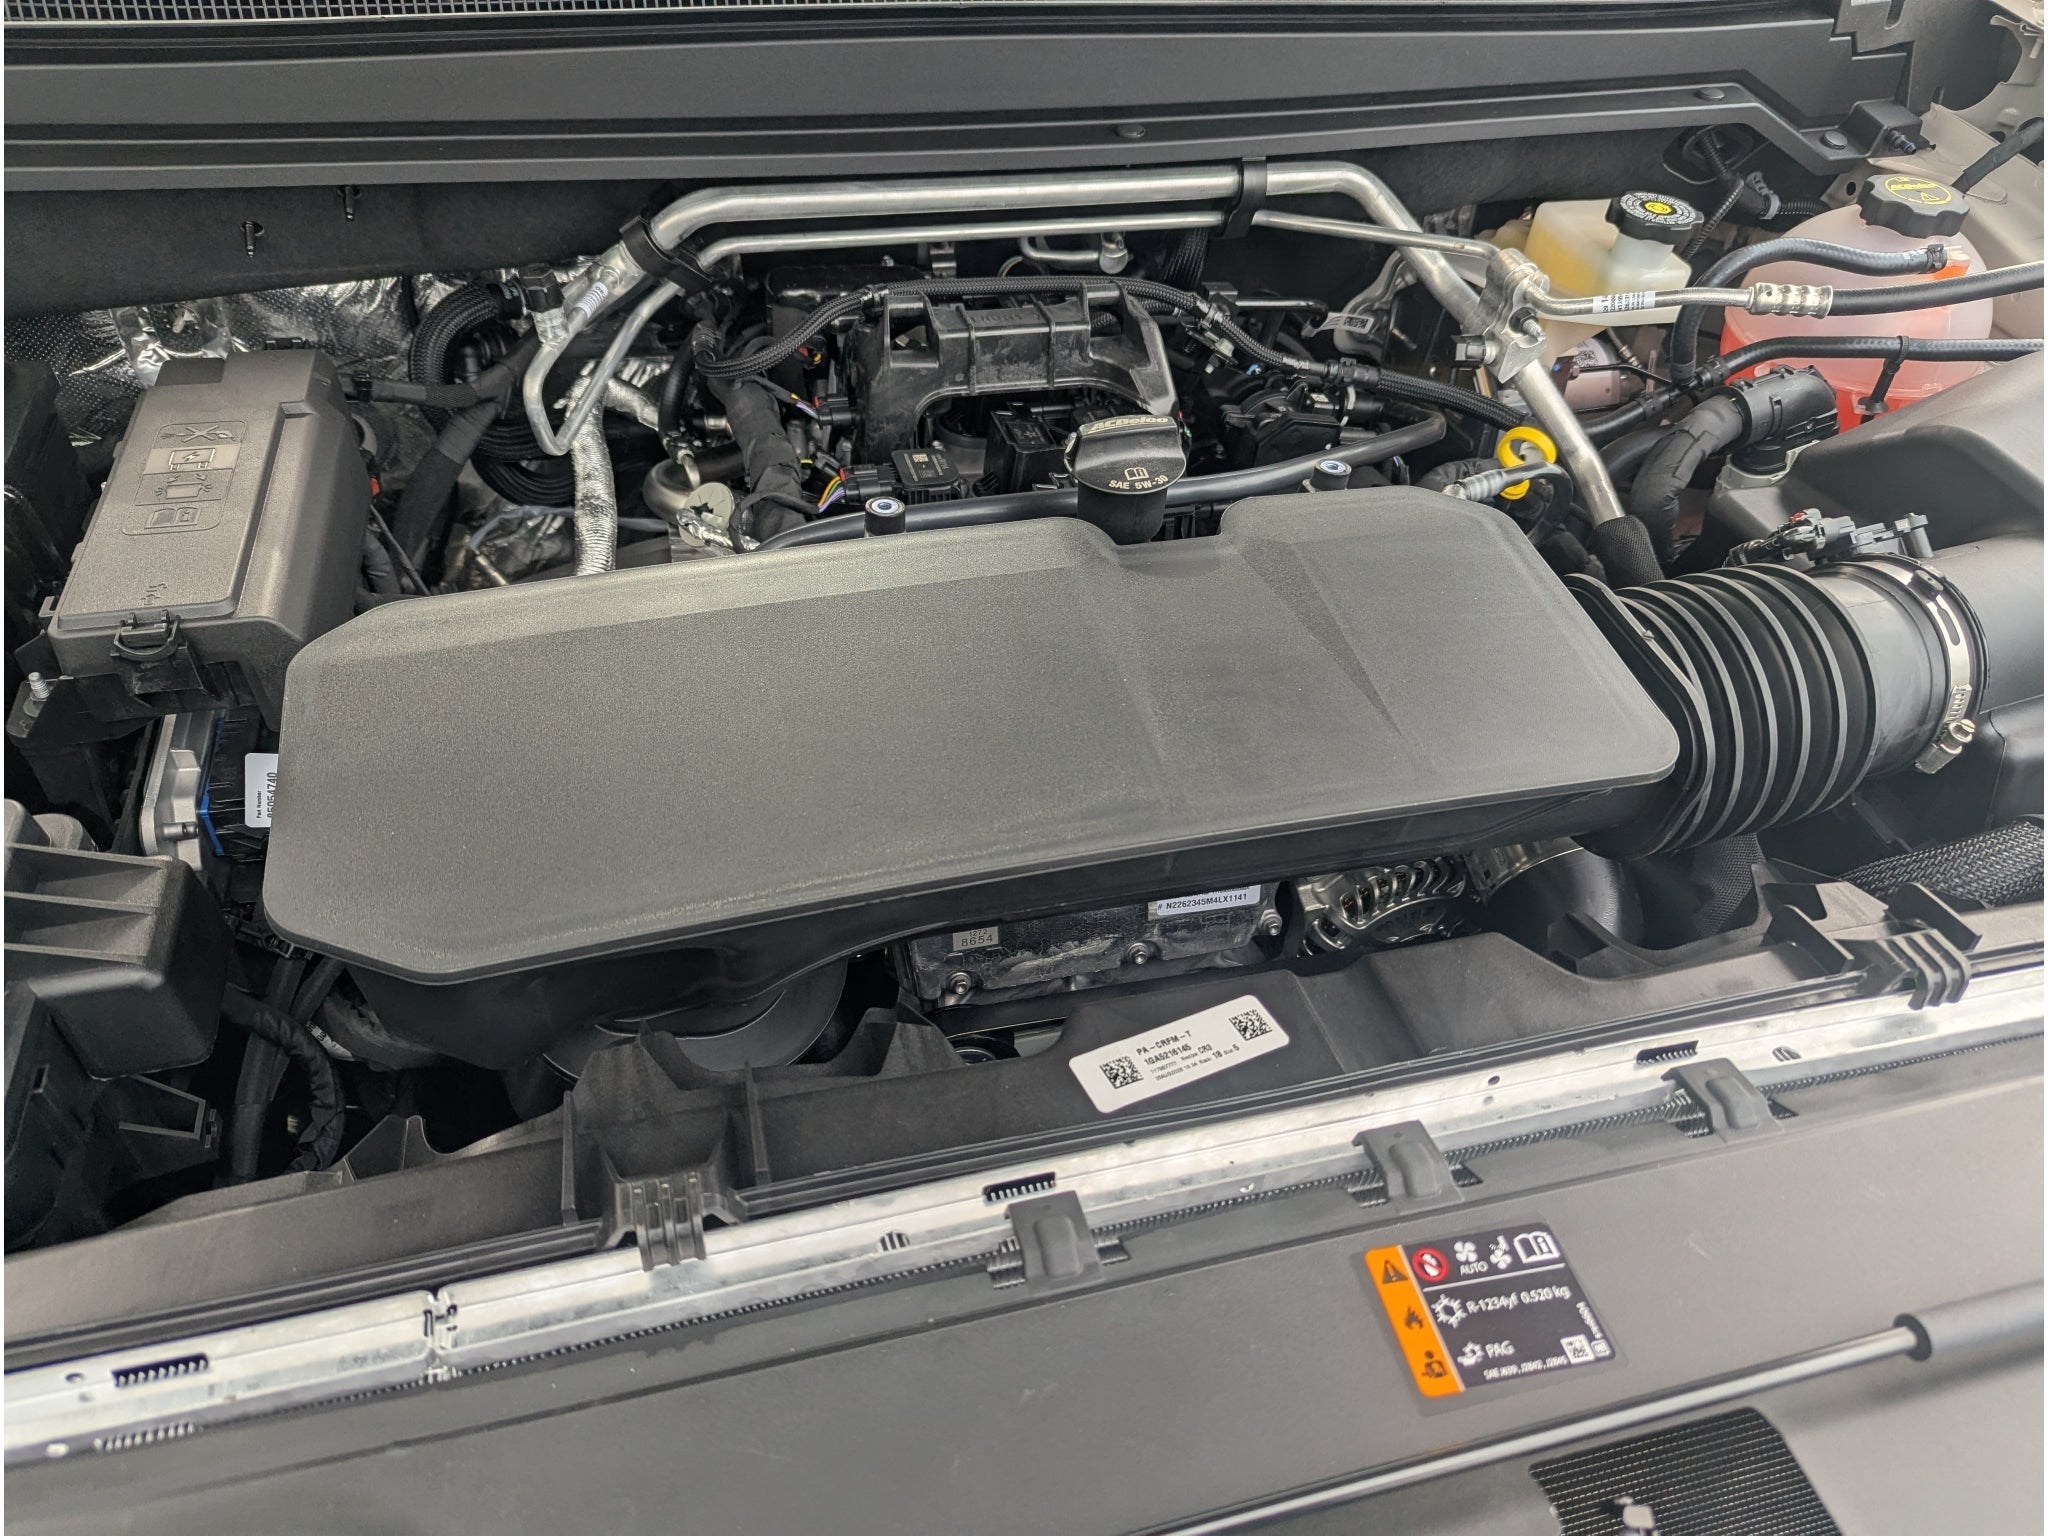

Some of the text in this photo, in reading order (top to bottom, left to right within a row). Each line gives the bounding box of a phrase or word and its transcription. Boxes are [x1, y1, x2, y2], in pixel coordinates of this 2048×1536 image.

[1087, 416, 1169, 434] ACDelco
[1108, 474, 1169, 490] SAE 5W-30
[961, 934, 993, 947] 8654
[1459, 1260, 1489, 1276] AUTO
[1465, 1284, 1573, 1315] R-1234yf 0.520 kg
[1485, 1340, 1515, 1359] PAG
